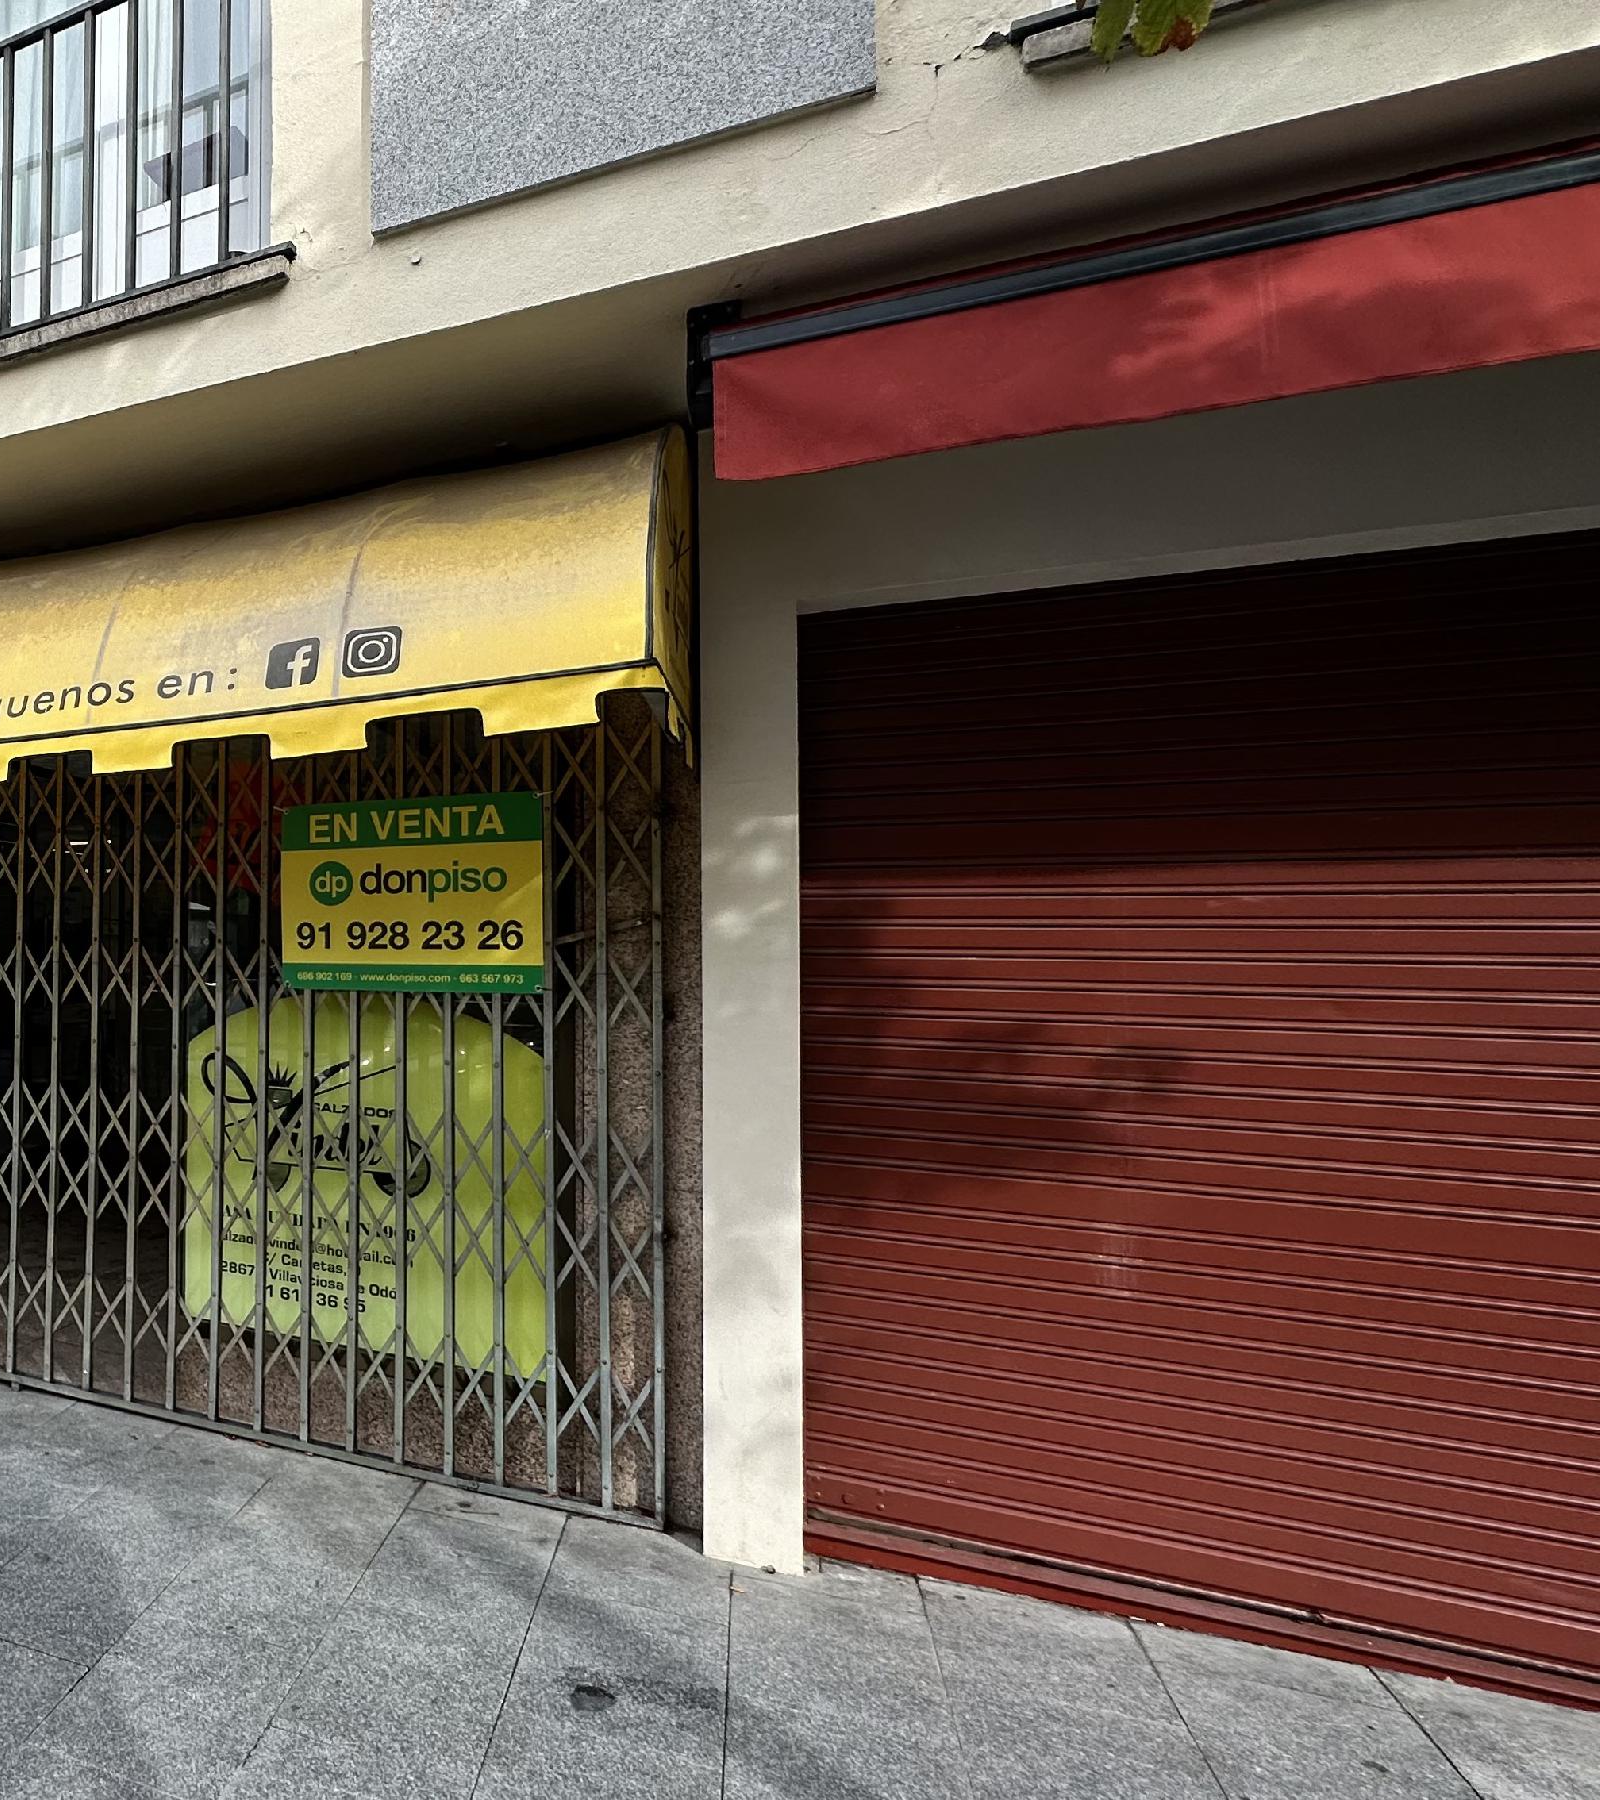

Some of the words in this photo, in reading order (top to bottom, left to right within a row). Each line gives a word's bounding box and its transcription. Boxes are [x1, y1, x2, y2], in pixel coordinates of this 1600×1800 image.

[309, 811, 358, 844] EN
[370, 803, 505, 841] VENTA
[314, 870, 348, 898] dp
[359, 860, 508, 904] donpiso
[296, 922, 331, 951] 91
[346, 920, 410, 951] 928
[421, 920, 466, 951] 23
[477, 919, 525, 951] 26
[359, 972, 451, 984] www.donpiso.com
[222, 1260, 257, 1277] 2867
[316, 1292, 339, 1309] 36
